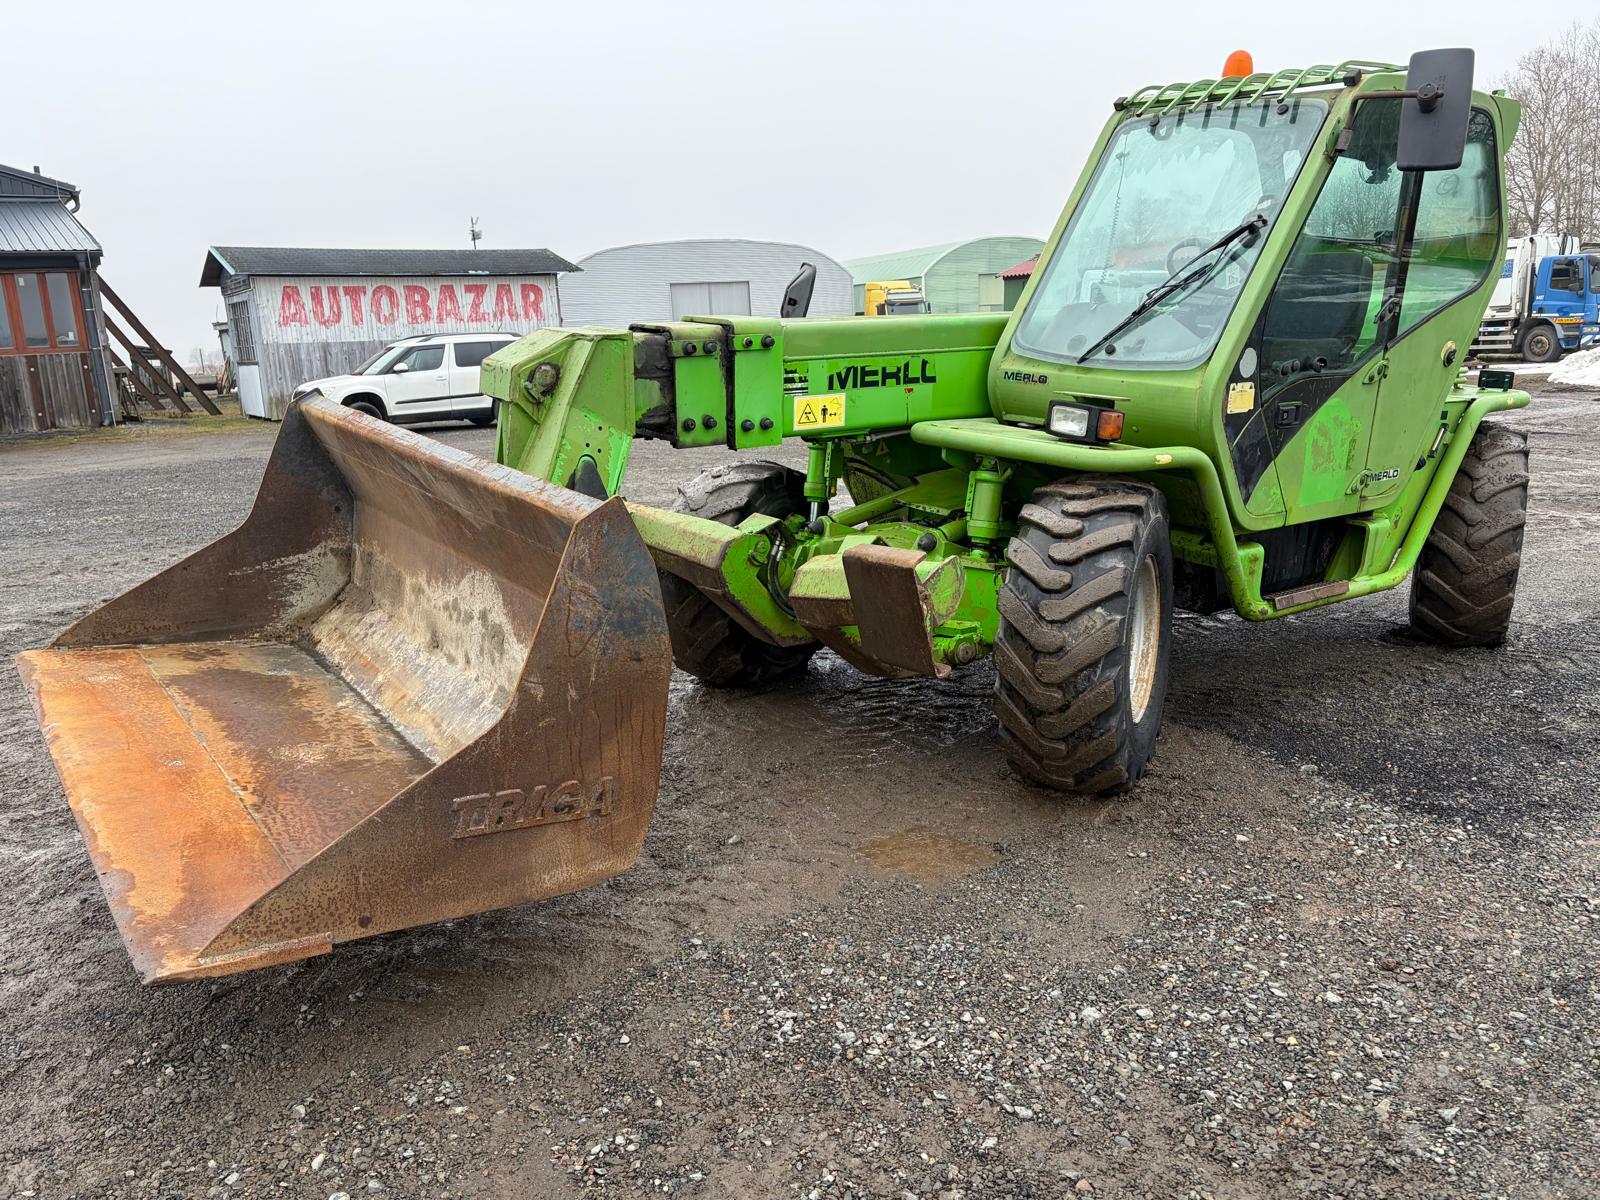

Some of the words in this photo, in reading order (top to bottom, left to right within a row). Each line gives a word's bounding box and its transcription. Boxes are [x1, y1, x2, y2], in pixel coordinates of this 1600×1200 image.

[279, 283, 545, 327] AUTOBAZAR
[1003, 371, 1048, 385] MERLO
[1370, 469, 1399, 482] MERLO
[451, 775, 613, 840] TRIGA
